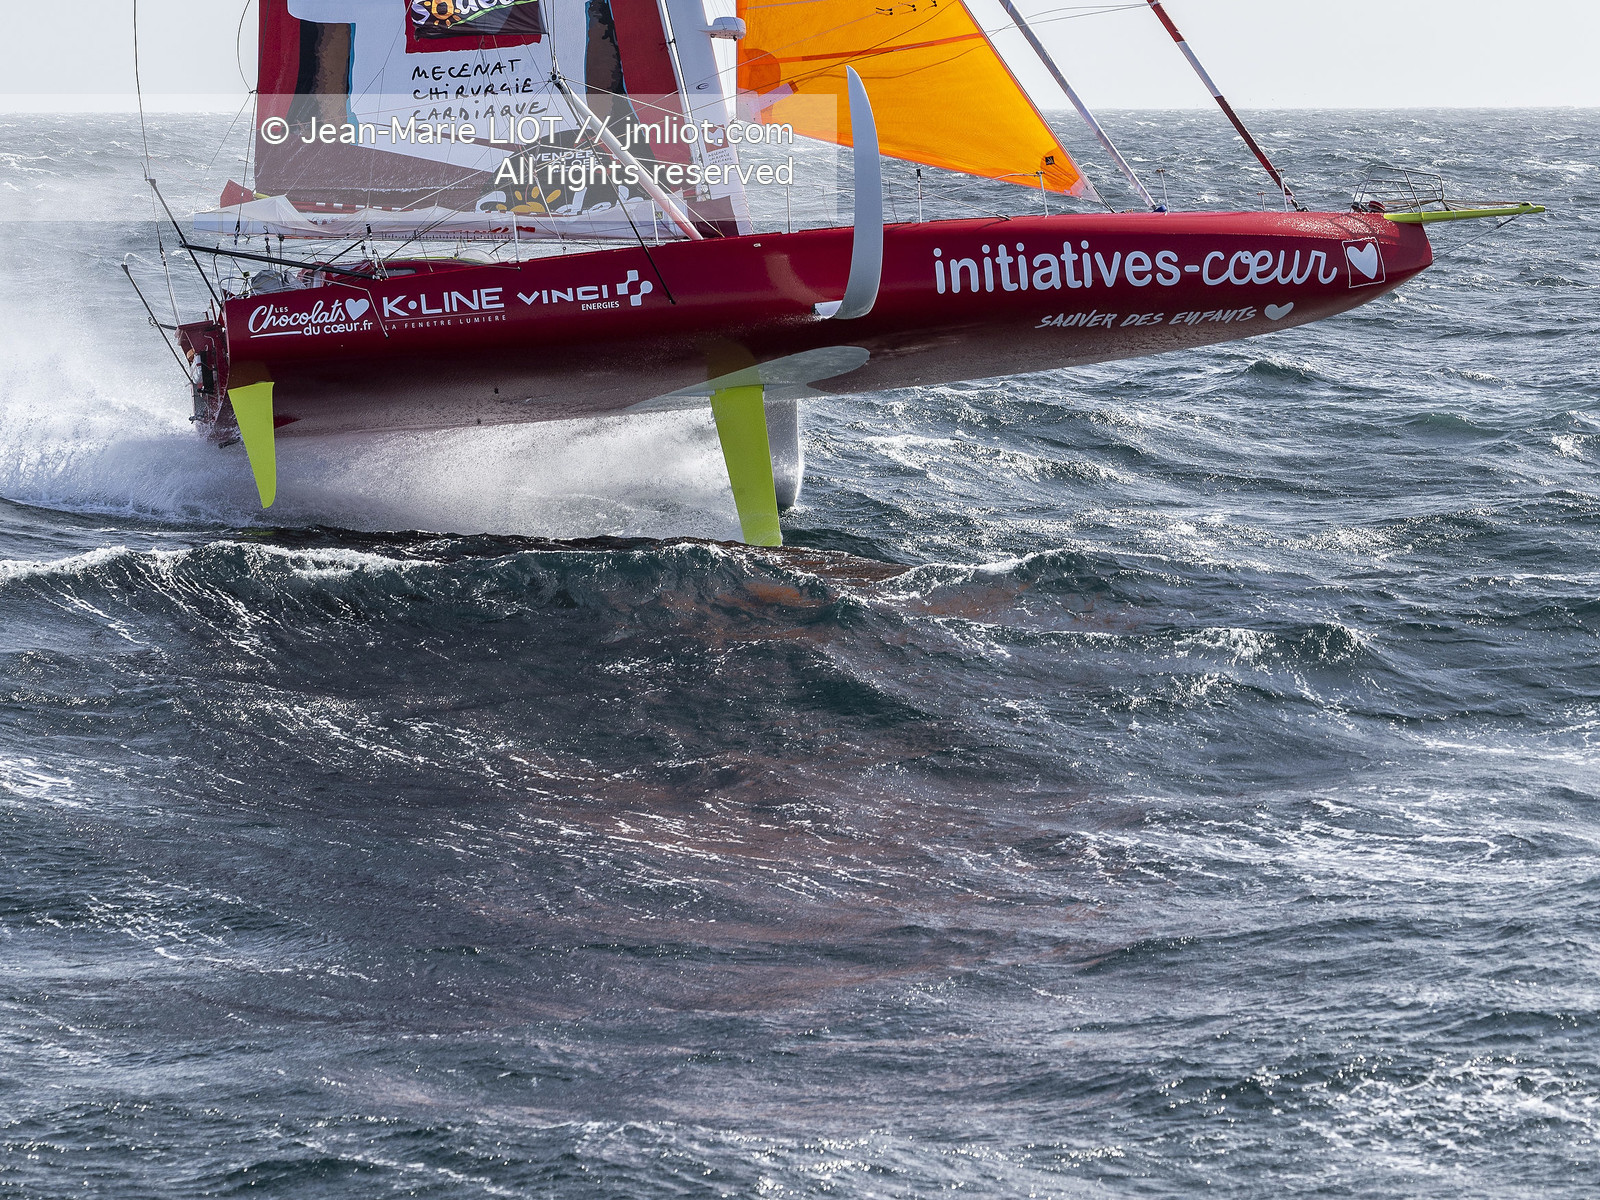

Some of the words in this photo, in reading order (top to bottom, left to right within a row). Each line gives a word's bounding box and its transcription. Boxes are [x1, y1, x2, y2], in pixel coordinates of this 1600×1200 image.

[411, 59, 522, 81] MECENAT
[516, 284, 609, 306] VINCI
[581, 300, 620, 311] ENERGIES
[248, 299, 346, 333] Chocolats
[1034, 309, 1118, 329] SAUVER
[1120, 312, 1164, 327] DES
[1168, 305, 1258, 326] ENFANTS
[303, 322, 321, 336] du
